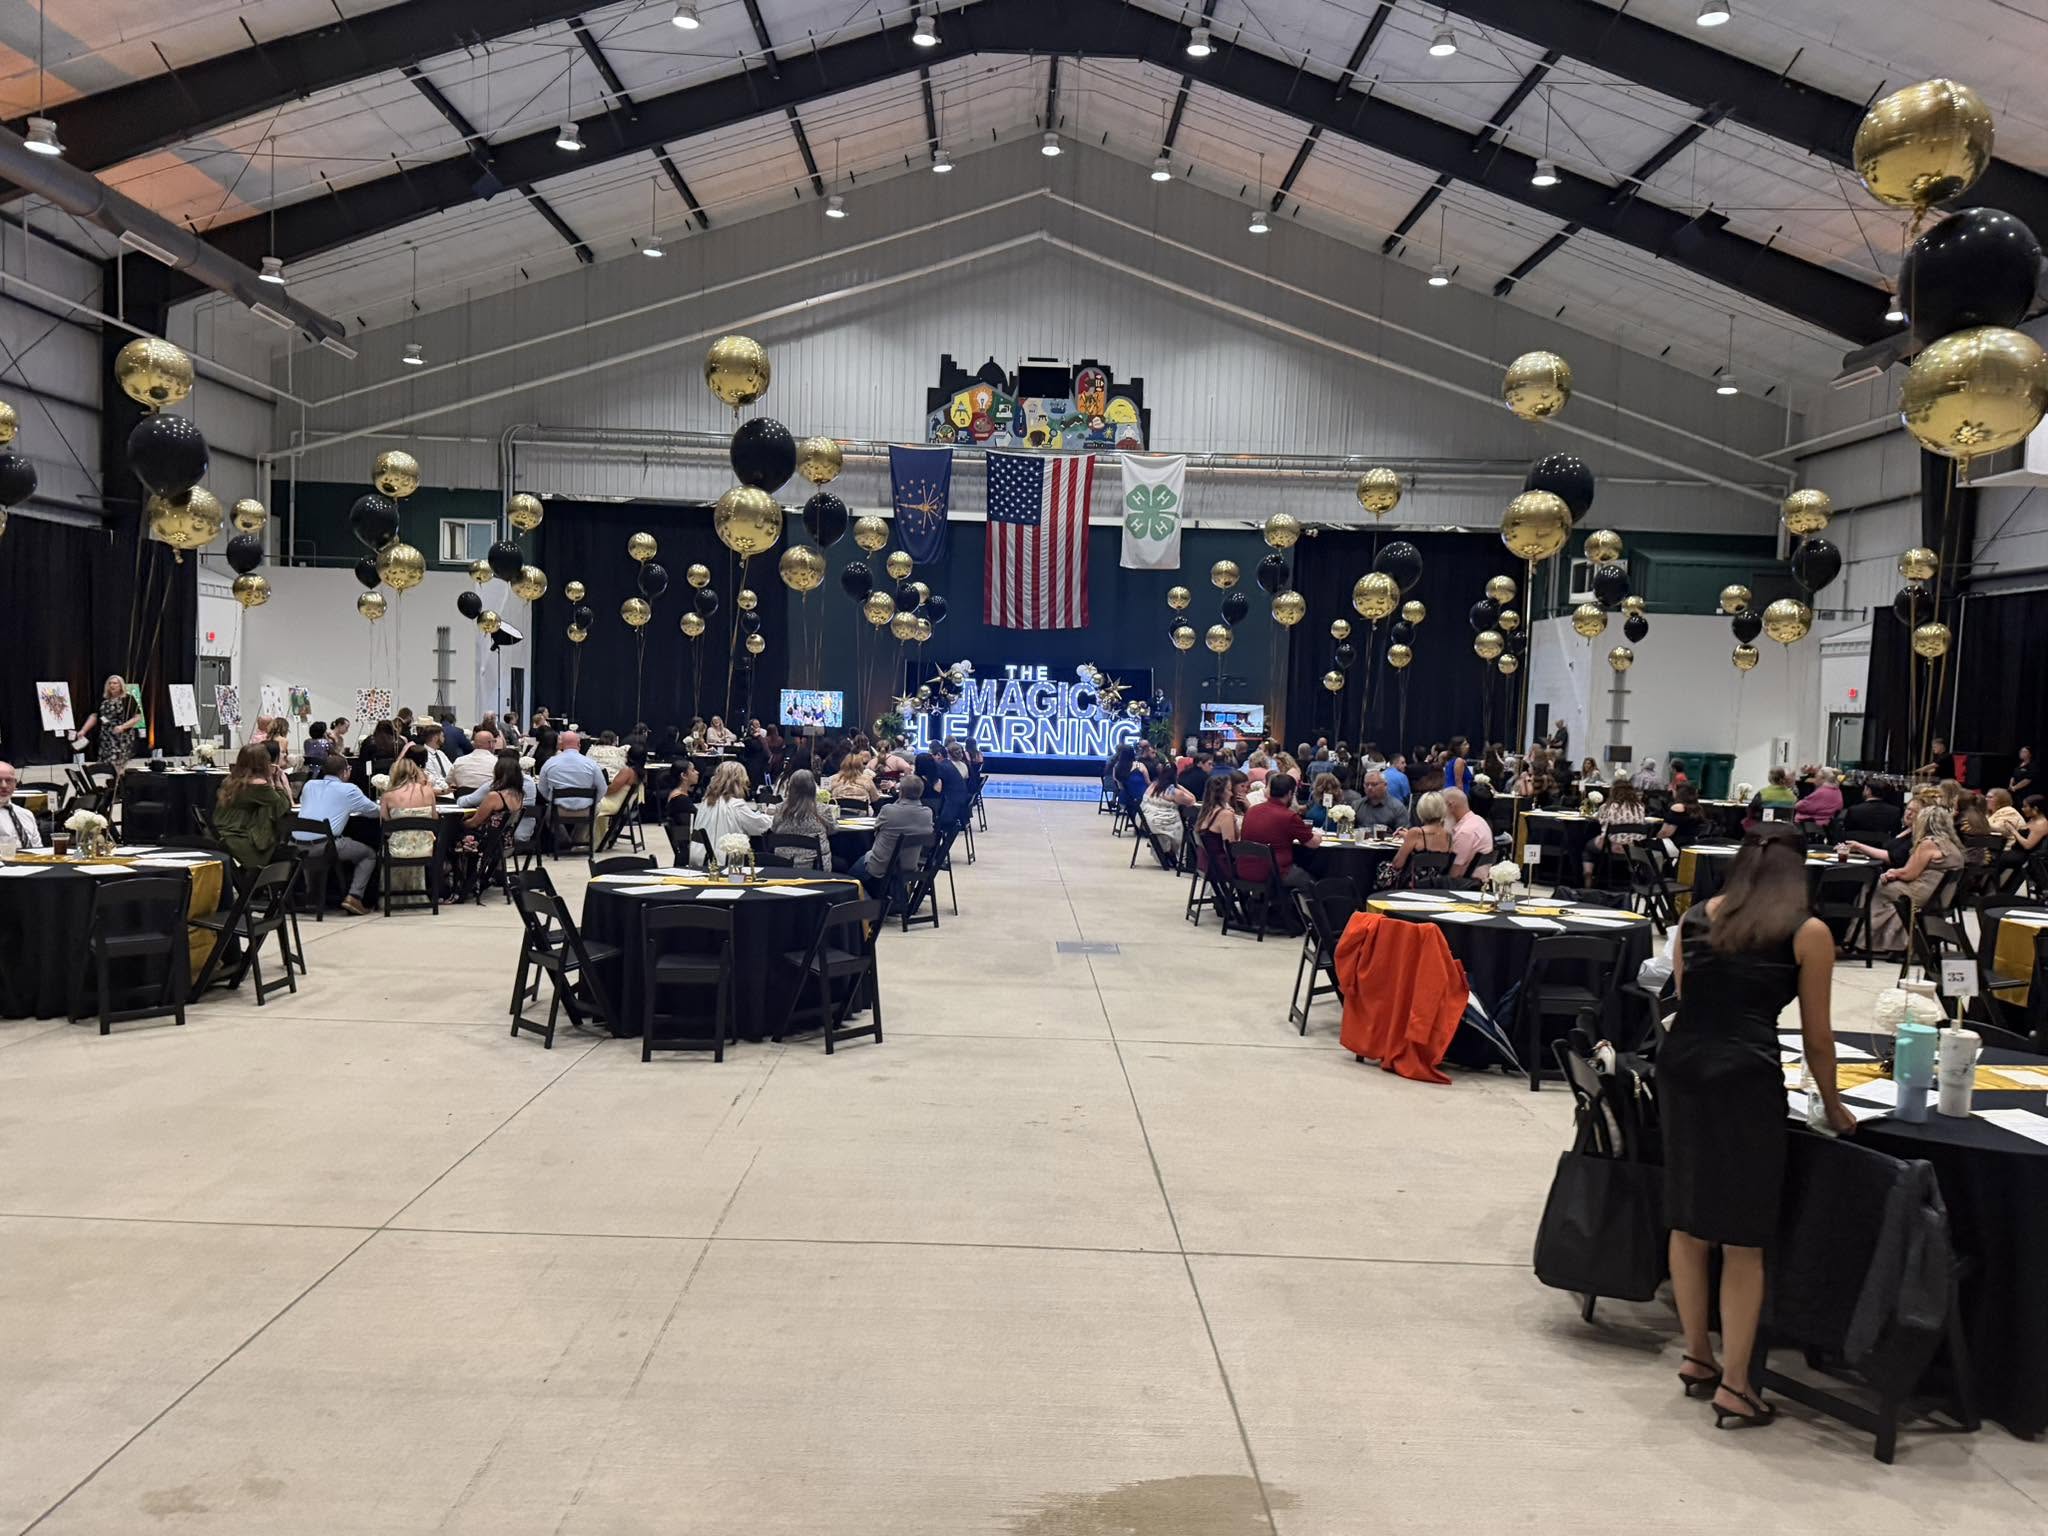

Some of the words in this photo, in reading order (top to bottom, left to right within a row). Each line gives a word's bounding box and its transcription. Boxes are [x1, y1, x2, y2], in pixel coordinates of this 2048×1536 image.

[1132, 491, 1146, 505] H
[1156, 491, 1170, 505] H
[1130, 518, 1144, 532] H
[1155, 520, 1168, 535] H
[1005, 664, 1048, 681] THE
[962, 678, 1097, 719] MAGIC
[917, 712, 1141, 756] LEARNING
